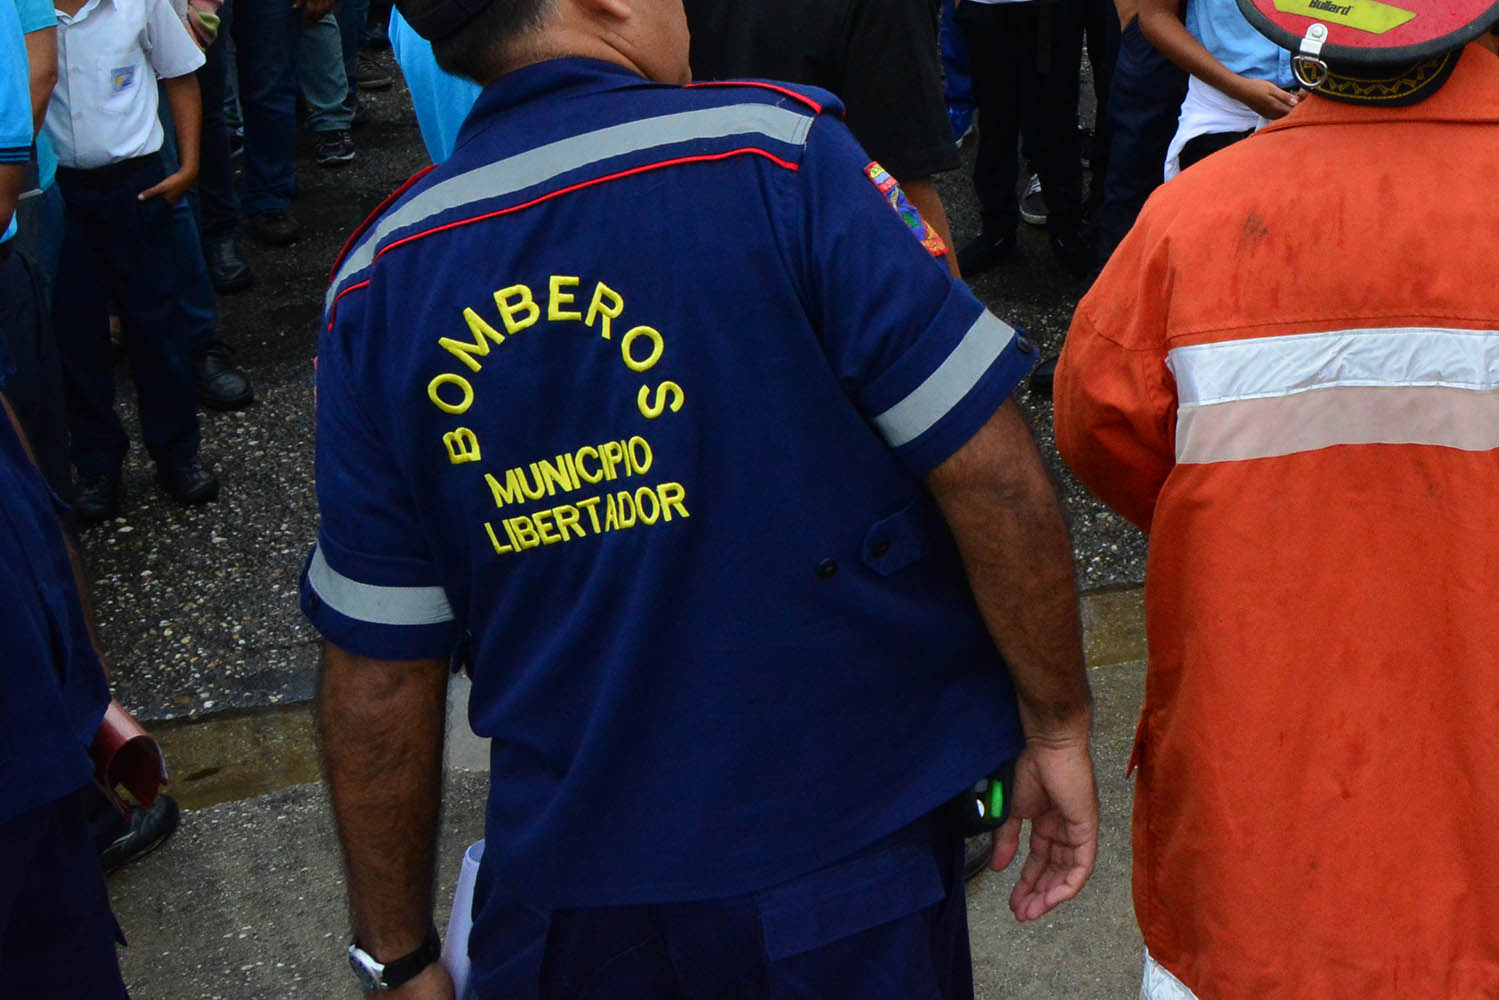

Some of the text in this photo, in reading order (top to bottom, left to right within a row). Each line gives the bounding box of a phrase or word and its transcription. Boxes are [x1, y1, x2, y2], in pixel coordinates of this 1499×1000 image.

[427, 274, 685, 465] BOMBEROS
[483, 435, 653, 508] MUNICIPIO
[483, 481, 691, 555] LIBERTADOR
